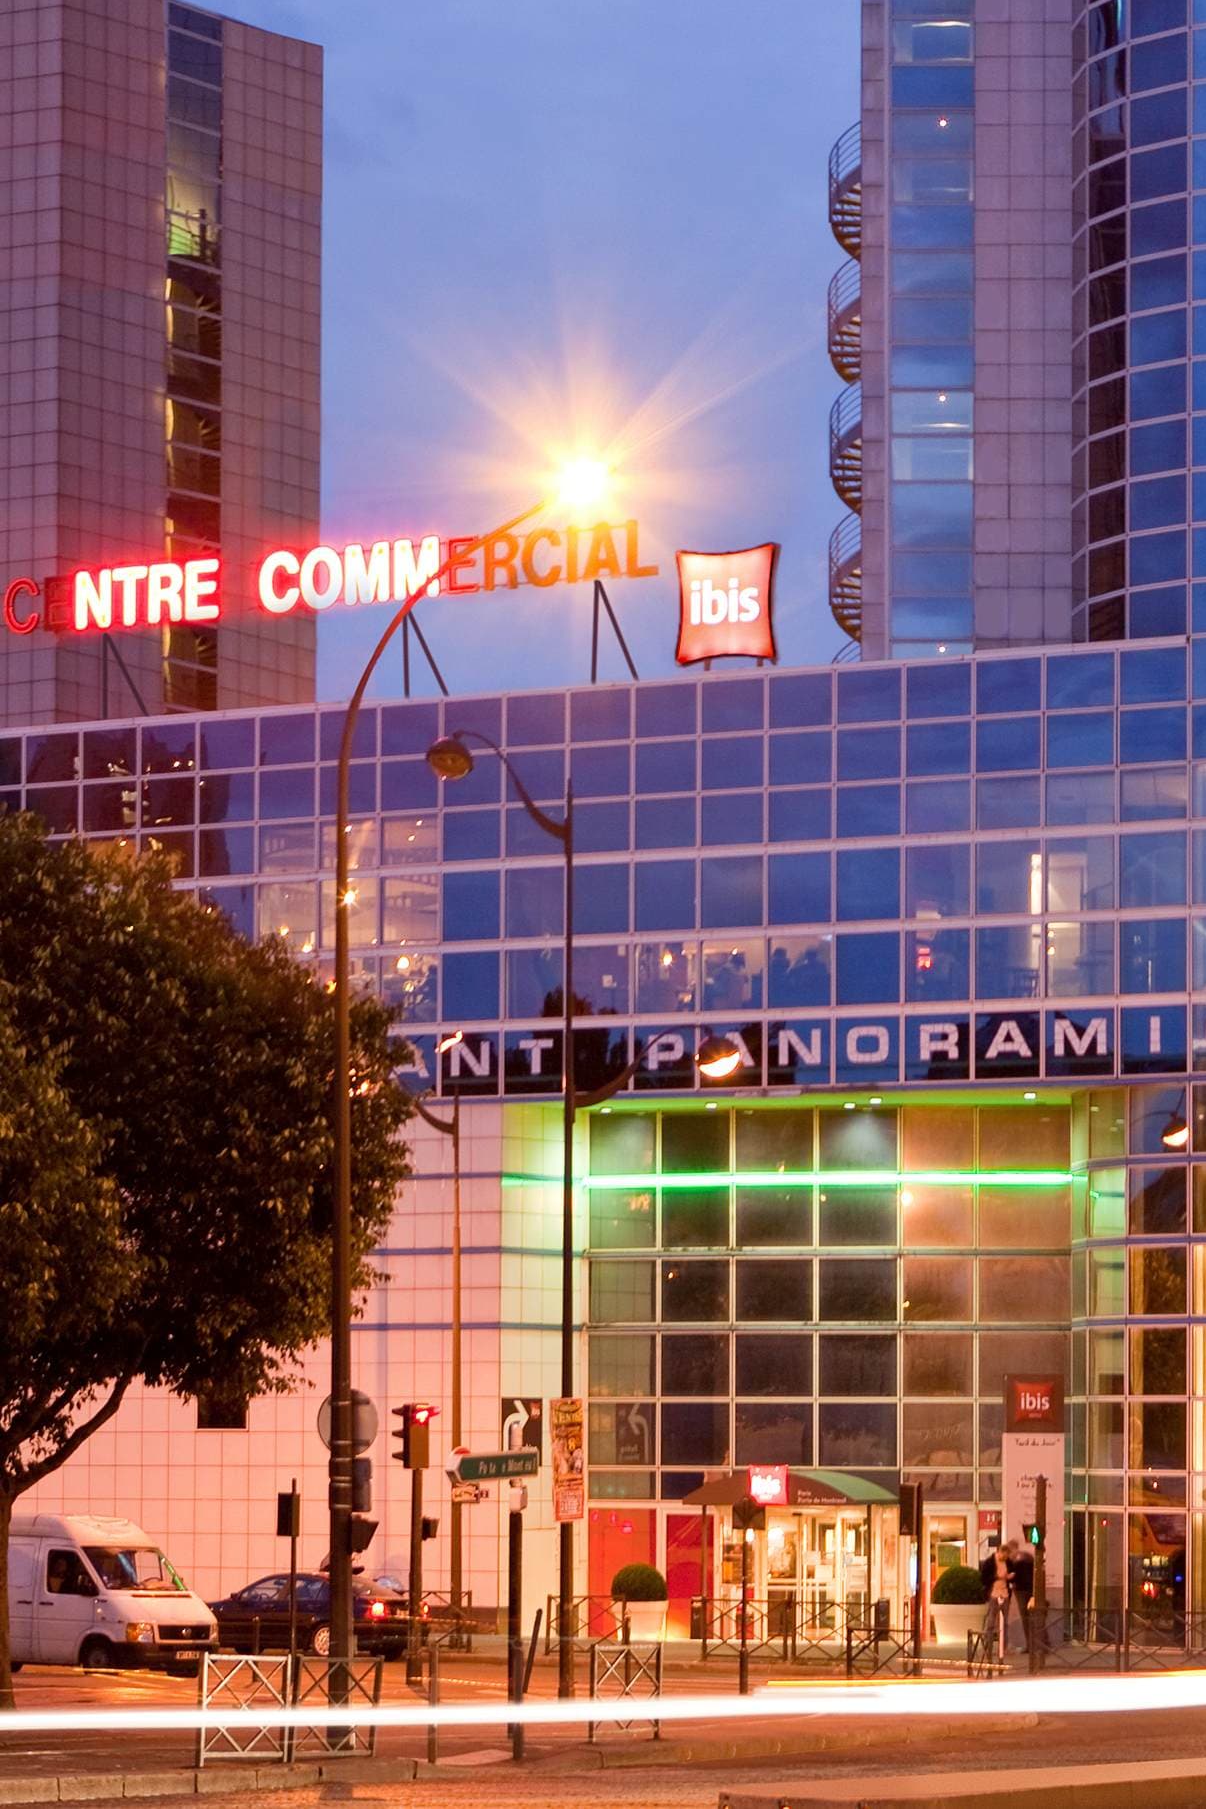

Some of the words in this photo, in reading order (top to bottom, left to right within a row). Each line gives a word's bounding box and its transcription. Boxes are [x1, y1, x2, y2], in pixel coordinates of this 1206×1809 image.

[257, 519, 659, 614] COMMERCIAL
[690, 577, 760, 626] ibis
[1020, 1392, 1050, 1410] ibis
